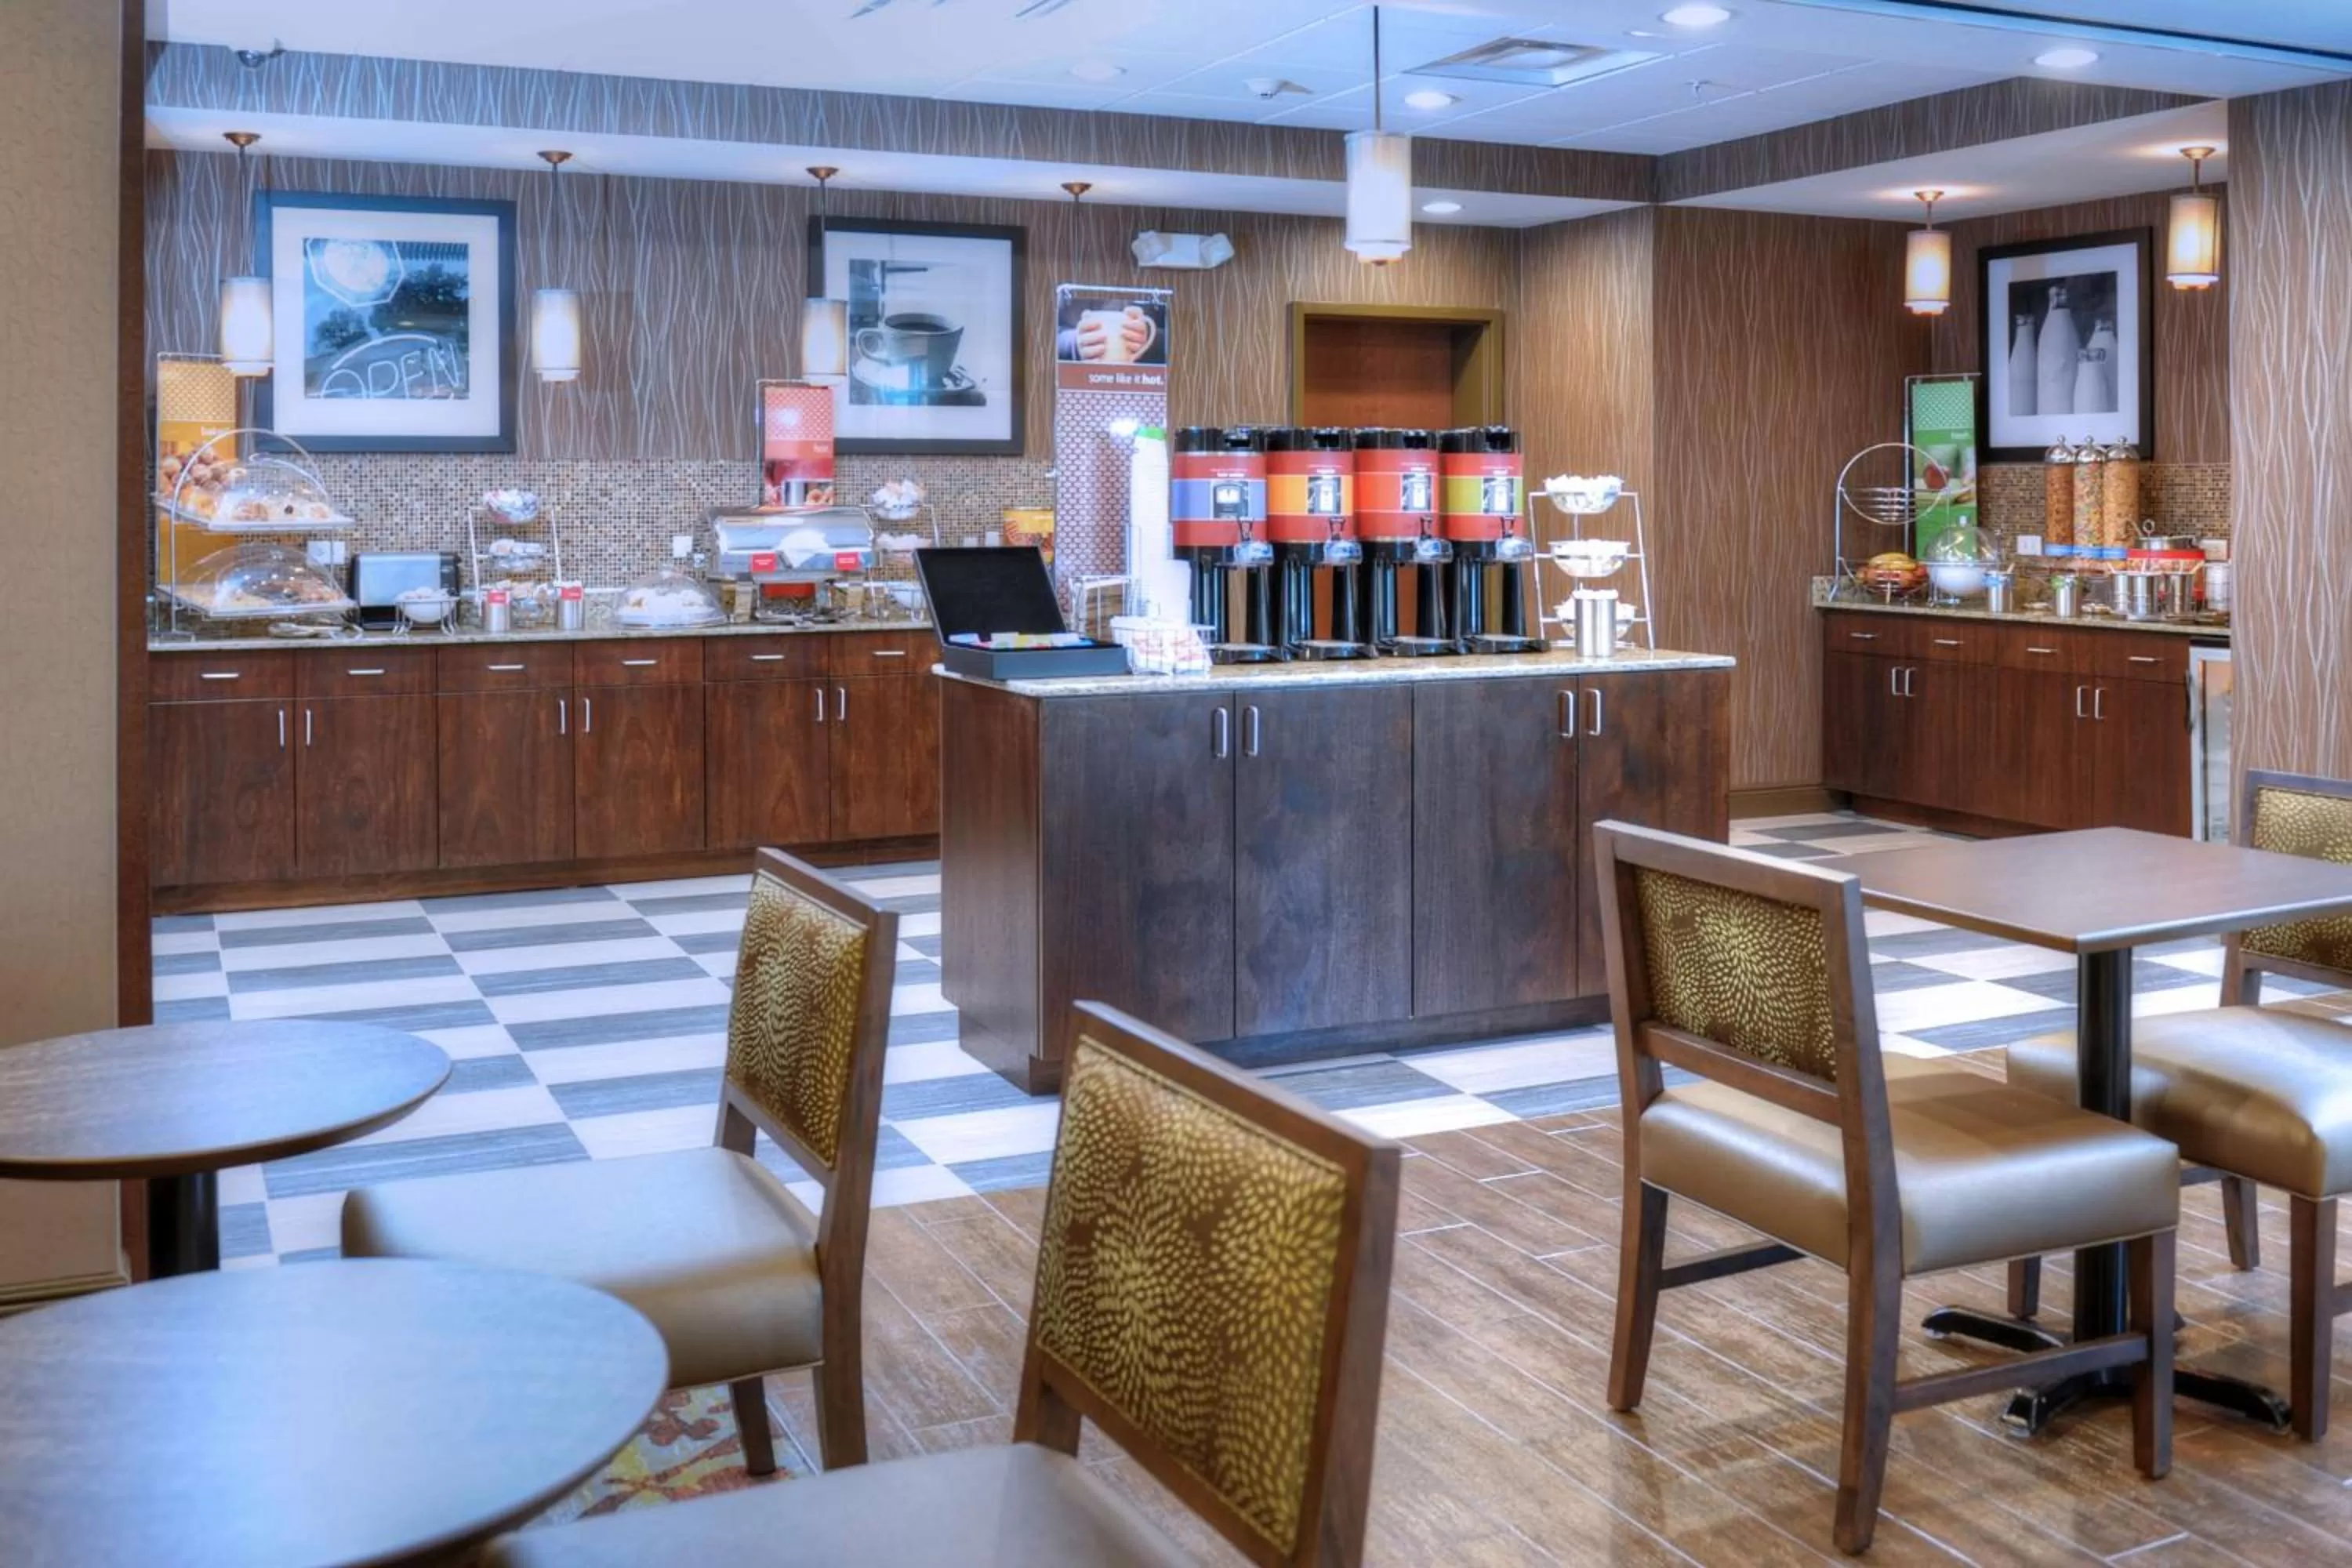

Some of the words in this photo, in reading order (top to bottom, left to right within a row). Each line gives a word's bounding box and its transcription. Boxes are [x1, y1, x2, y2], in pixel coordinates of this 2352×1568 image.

[321, 343, 459, 399] OPEN
[1088, 373, 1114, 383] some
[1116, 372, 1132, 383] like
